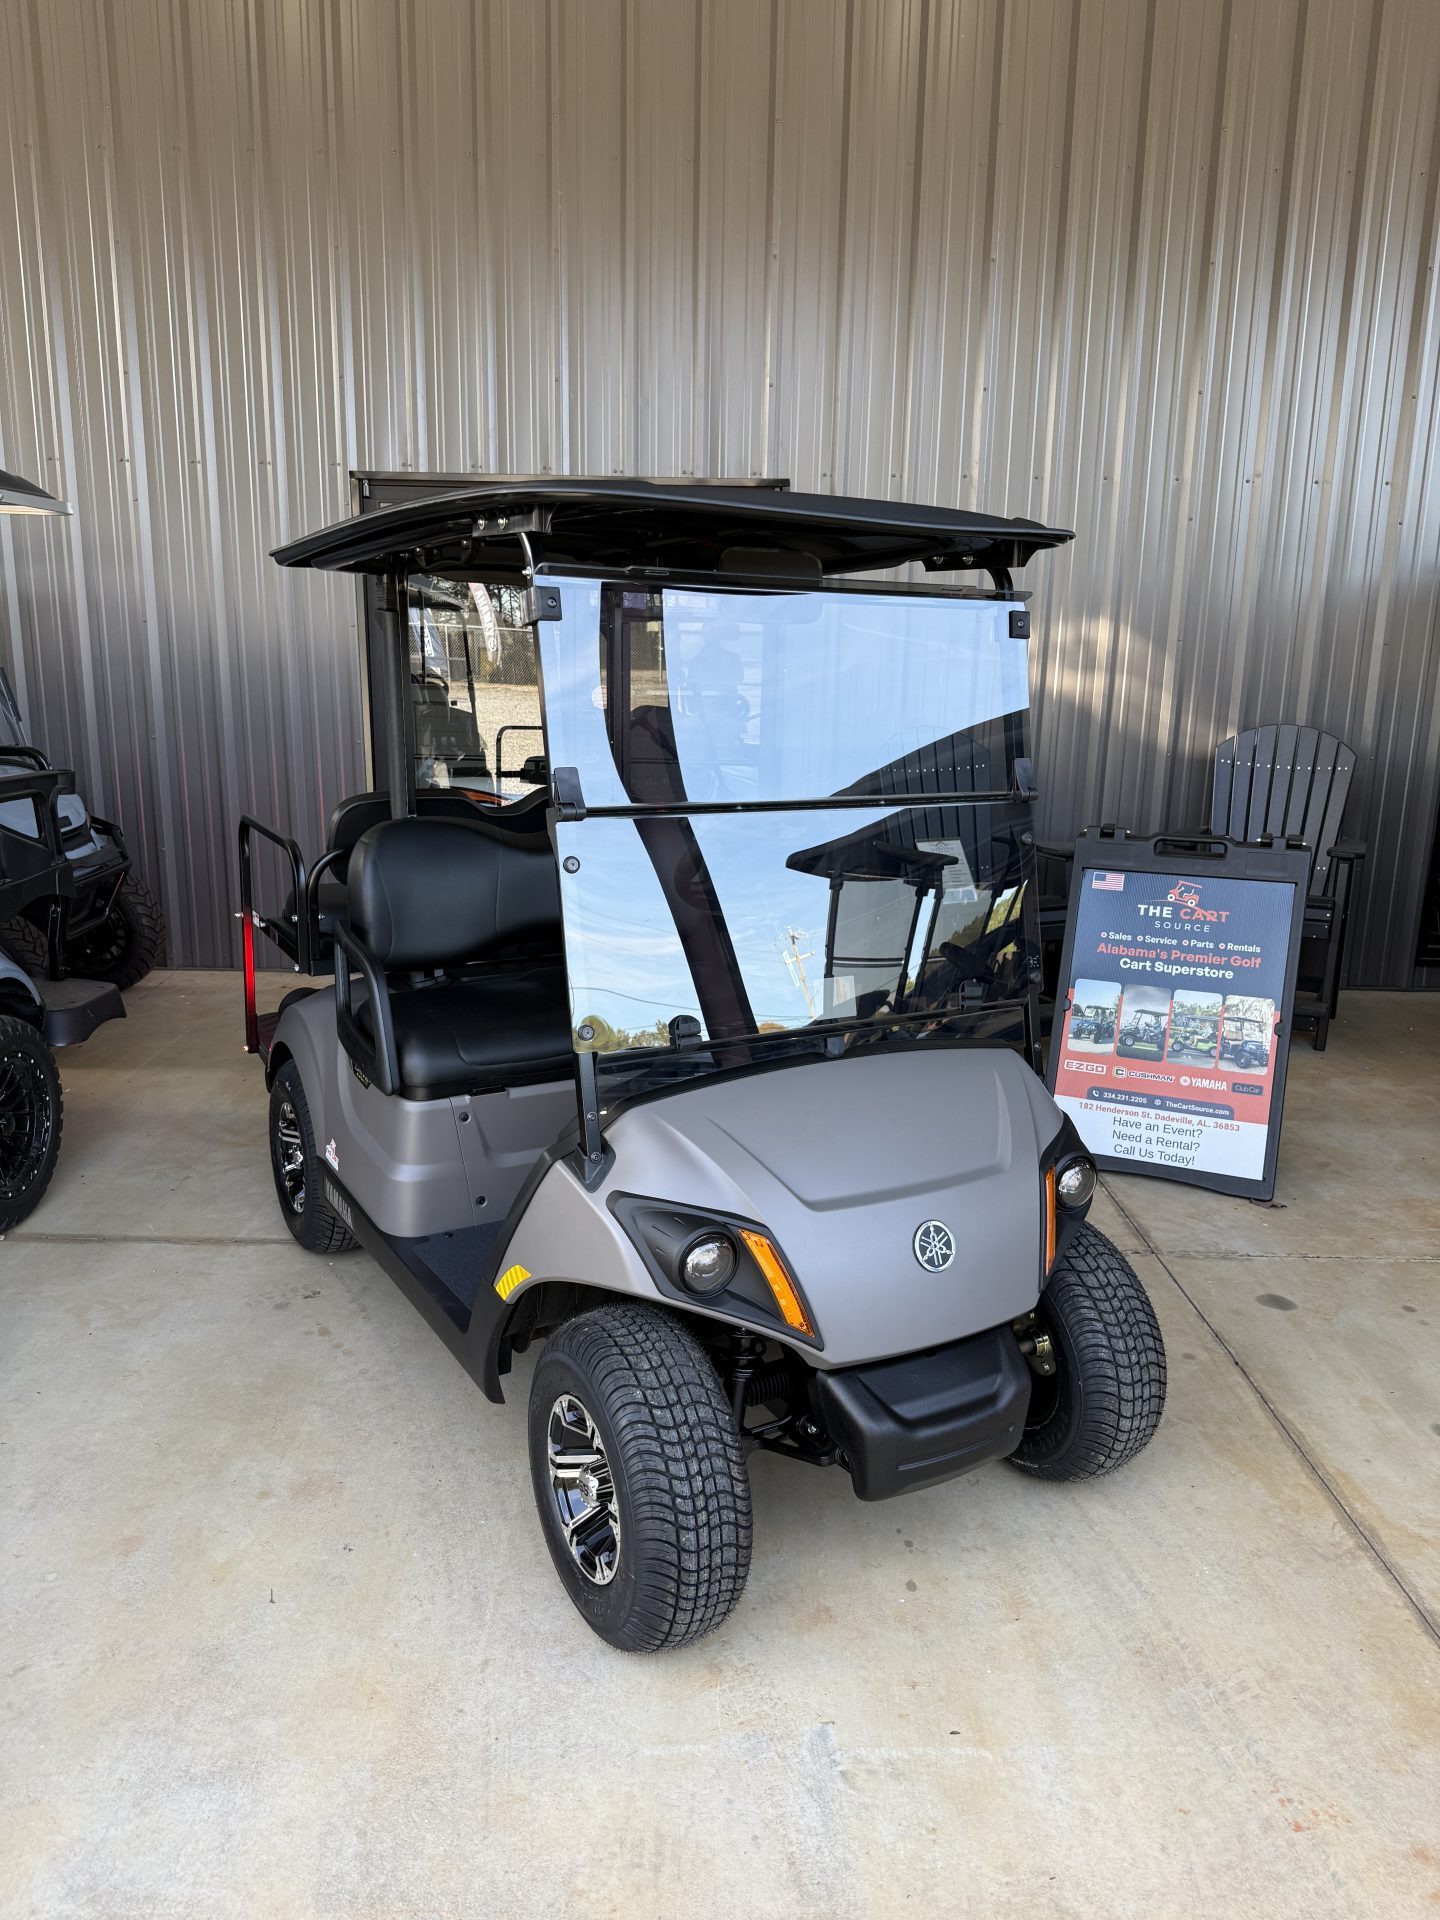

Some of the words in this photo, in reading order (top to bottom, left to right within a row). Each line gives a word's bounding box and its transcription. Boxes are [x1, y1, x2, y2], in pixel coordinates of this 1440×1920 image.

[1138, 904, 1173, 918] THE
[1180, 908, 1230, 923] CART
[1154, 920, 1211, 933] SOURCE
[1108, 932, 1133, 941] Sales
[1145, 935, 1178, 946] Service
[1190, 939, 1215, 949] Parts
[1227, 942, 1261, 953] Rentals
[1097, 942, 1168, 960] Alabama's
[1171, 950, 1228, 966] Premier
[1230, 955, 1262, 969] Golf
[1119, 957, 1152, 971] Cart
[1154, 961, 1235, 980] Superstore
[1128, 1071, 1174, 1082] CUSHMAN
[1191, 1077, 1227, 1091] YAMAHA
[1103, 1091, 1148, 1104] 334.231.2205
[1165, 1100, 1230, 1116] TheCartSource.com
[1079, 1102, 1094, 1110] 182
[1095, 1104, 1139, 1117] Henderson
[1141, 1111, 1153, 1119] St.
[1154, 1113, 1195, 1127] Dadeville,
[1197, 1119, 1211, 1128] AL.
[1213, 1121, 1240, 1132] 36853
[1112, 1116, 1142, 1129] Have
[1145, 1123, 1159, 1132] an
[1163, 1124, 1203, 1138] Event?
[1112, 1129, 1143, 1143] Need
[1145, 1136, 1153, 1145] a
[1156, 1136, 1201, 1152] Rental?
[1113, 1143, 1136, 1156] Call
[1138, 1147, 1155, 1159] Us
[1157, 1150, 1196, 1166] Today!
[325, 1177, 354, 1230] YAMAHA
